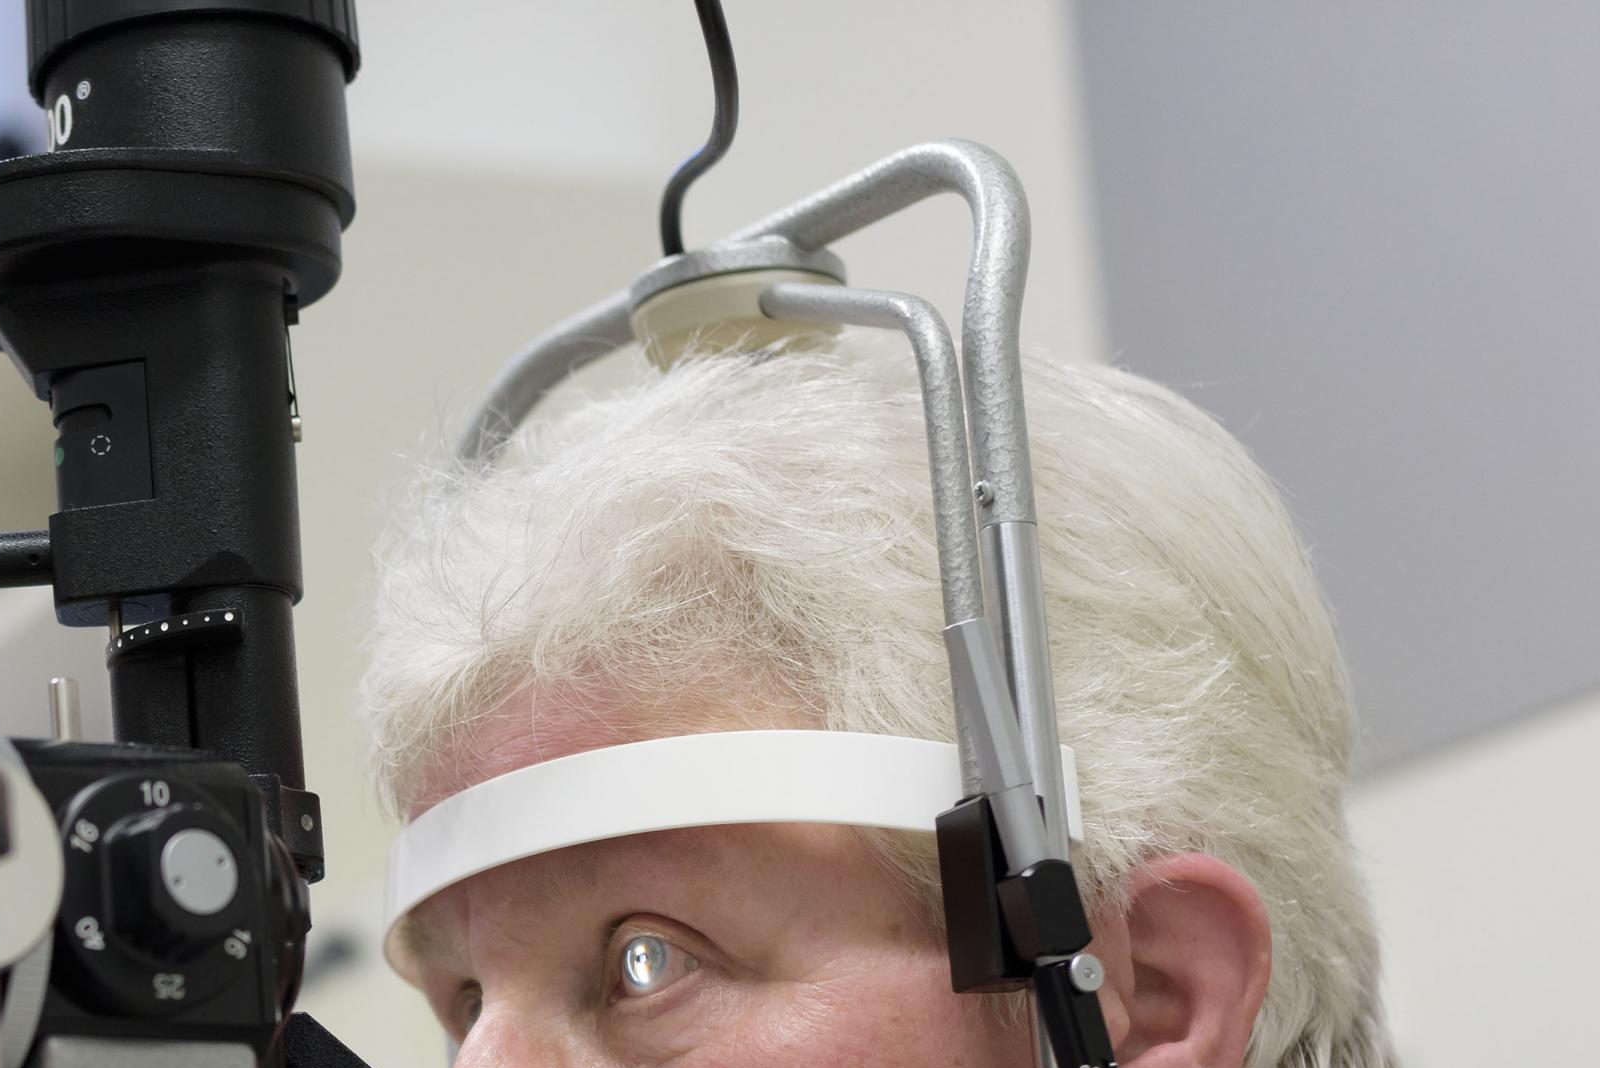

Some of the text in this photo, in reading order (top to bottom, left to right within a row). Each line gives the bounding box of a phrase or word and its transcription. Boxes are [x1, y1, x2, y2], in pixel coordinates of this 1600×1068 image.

[139, 779, 171, 807] 10
[70, 817, 100, 854] 16
[223, 928, 253, 961] 16
